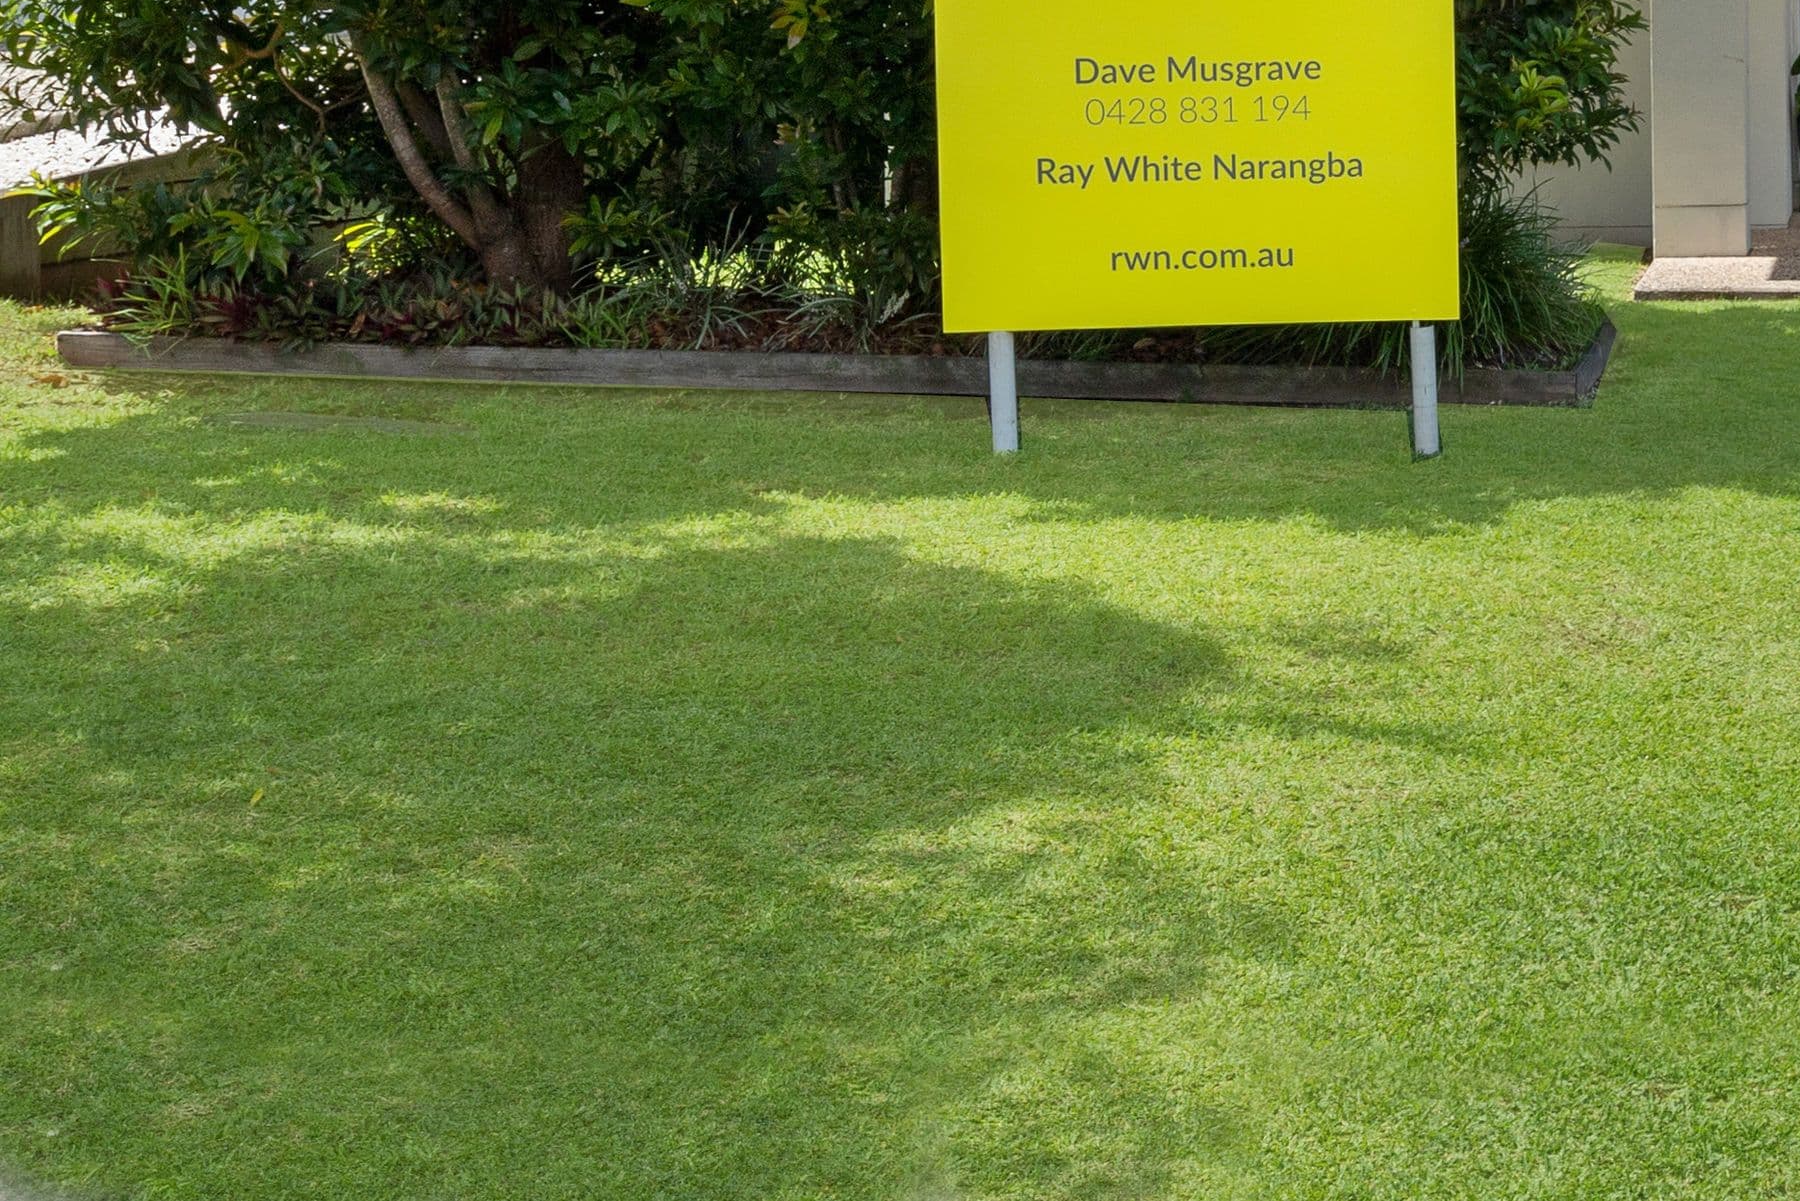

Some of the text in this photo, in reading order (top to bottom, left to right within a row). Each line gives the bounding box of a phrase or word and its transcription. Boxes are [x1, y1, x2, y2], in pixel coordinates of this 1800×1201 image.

[1075, 55, 1322, 87] Dave Musgrave
[1085, 95, 1311, 126] 0428 831 194
[1036, 151, 1363, 189] Ray White Narangba
[1111, 247, 1294, 272] rwn.com.au
